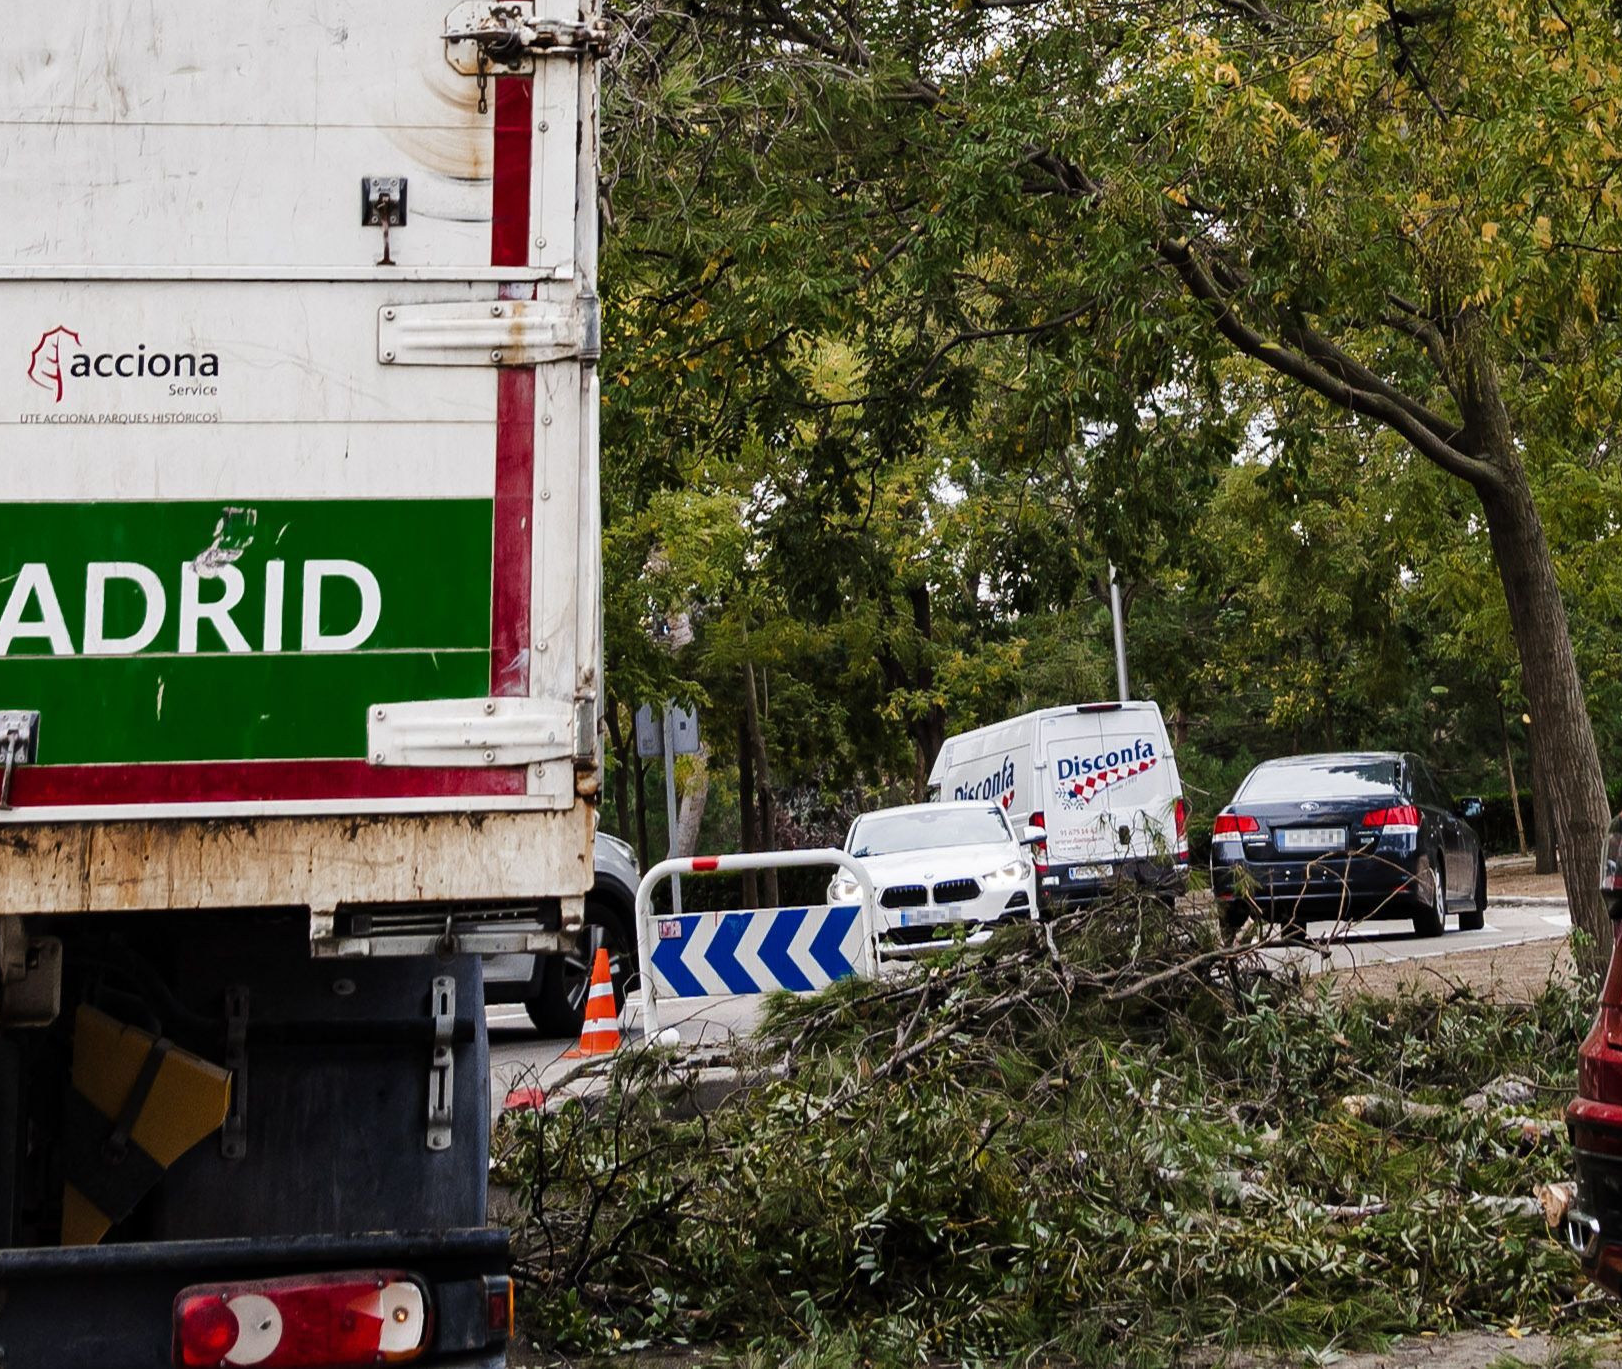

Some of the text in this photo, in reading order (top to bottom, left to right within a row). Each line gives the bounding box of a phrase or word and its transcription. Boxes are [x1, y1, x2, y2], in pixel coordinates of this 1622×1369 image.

[70, 344, 219, 377] acciona
[168, 383, 218, 397] Service
[20, 411, 218, 425] UTE ACCIONA PARQUES HISTÓRICOS
[1057, 738, 1155, 780] Disconfa
